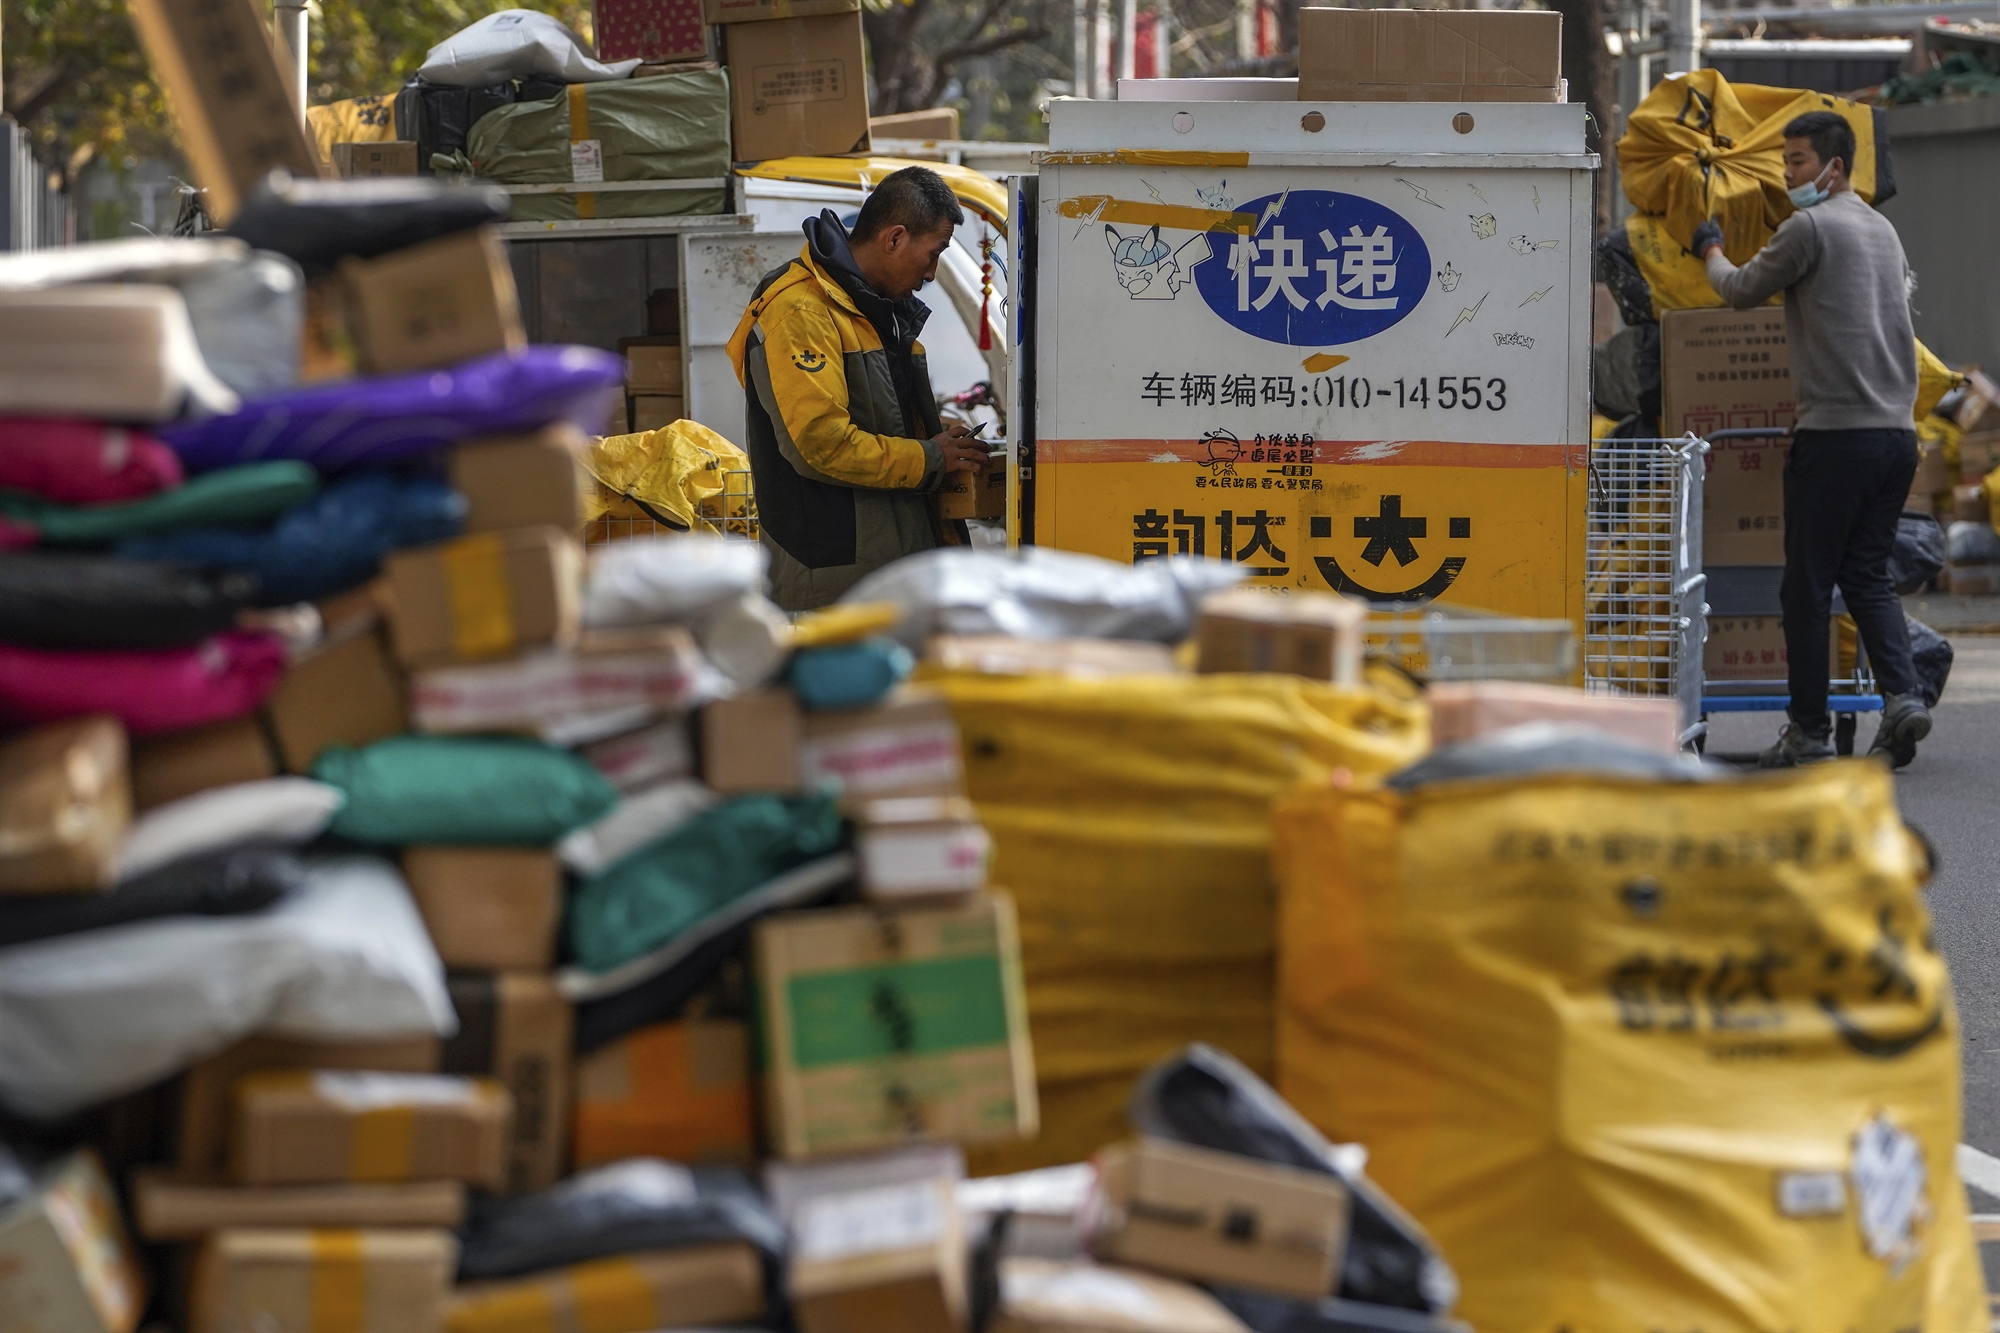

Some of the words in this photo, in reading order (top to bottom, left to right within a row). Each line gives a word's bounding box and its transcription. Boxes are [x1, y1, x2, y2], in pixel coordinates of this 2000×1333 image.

[1226, 224, 1400, 312] 快递
[1253, 432, 1316, 448] 小伙单身
[1250, 448, 1315, 464] 追尾必娶
[1195, 476, 1258, 489] 要么民政局
[1261, 478, 1324, 491] 要么警察局
[1133, 508, 1291, 576] 韵达
